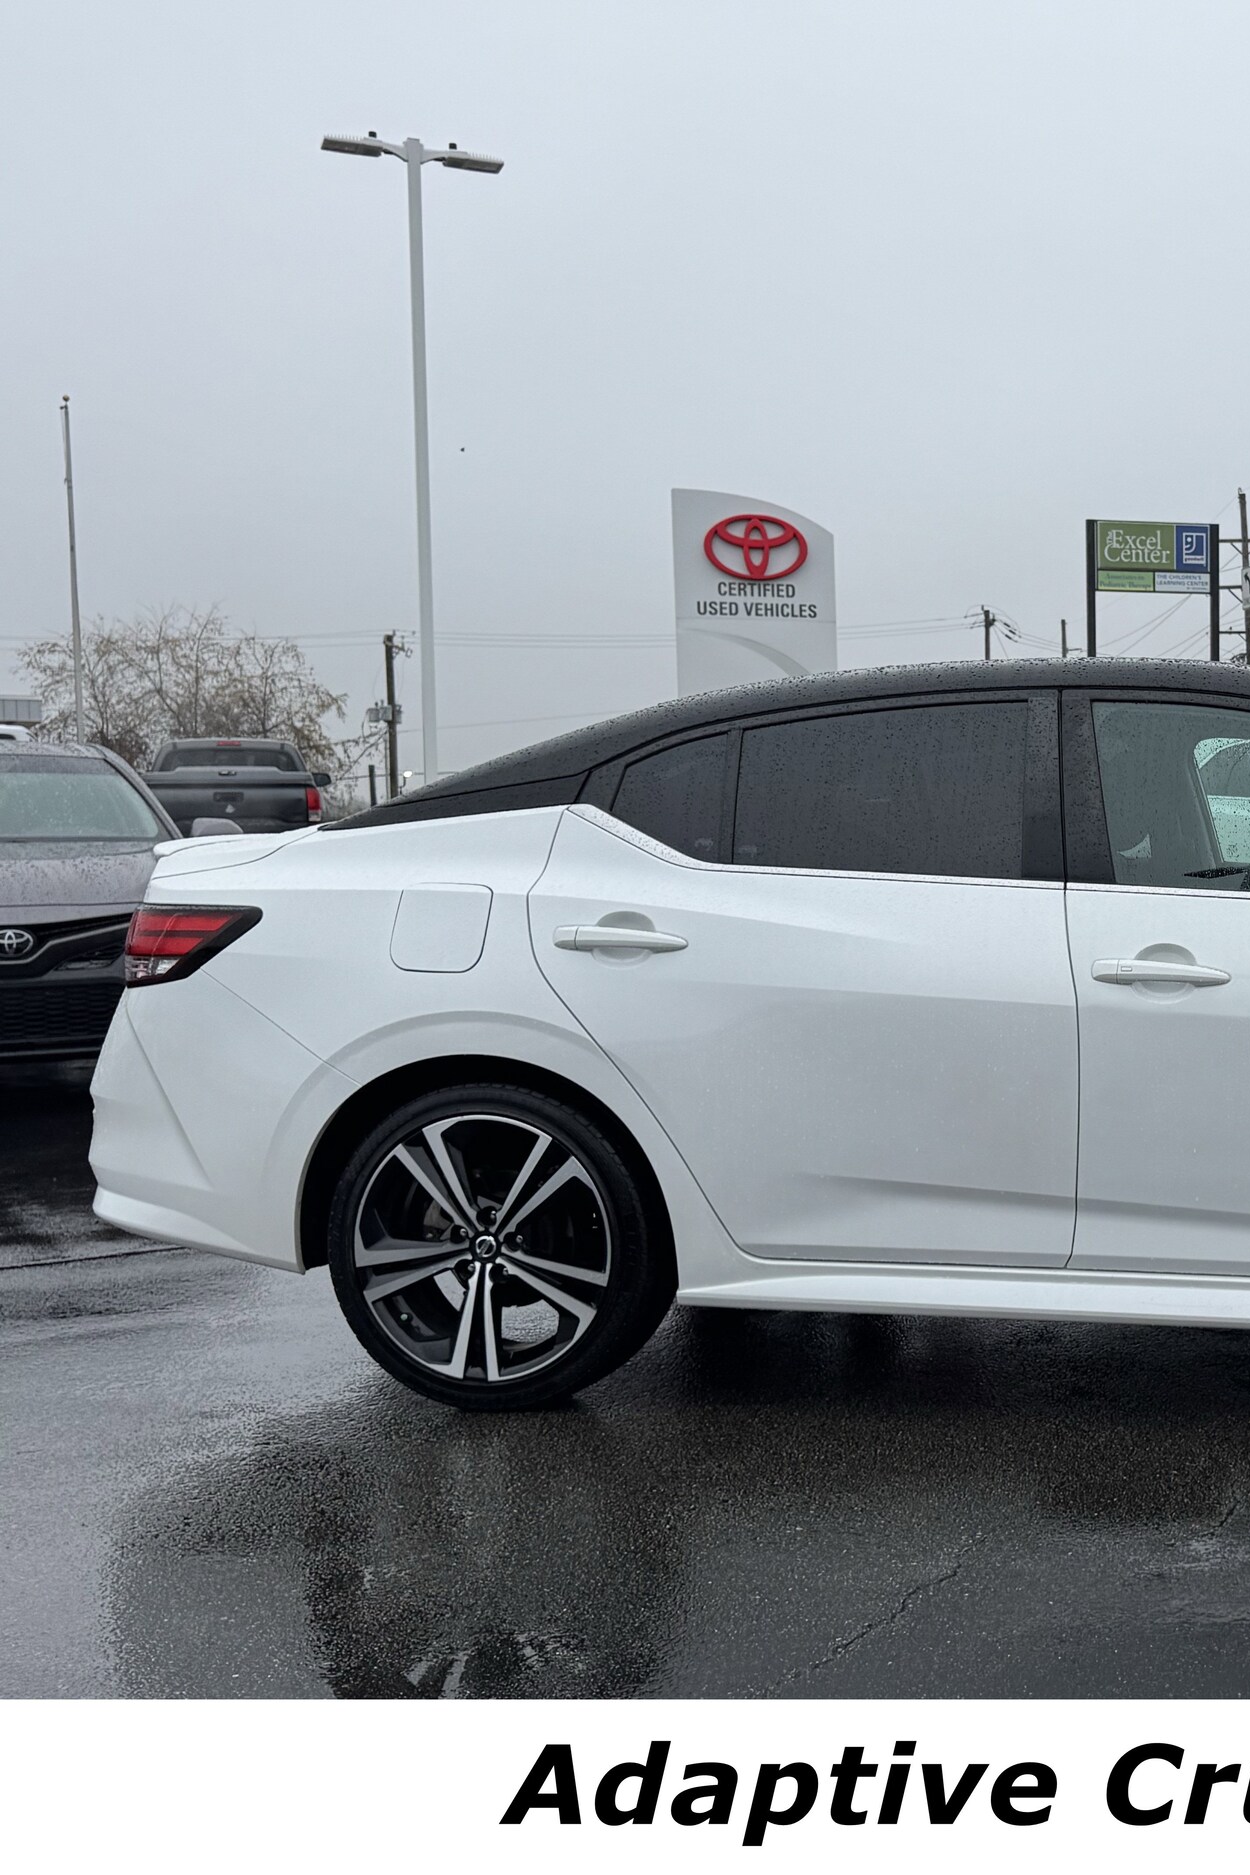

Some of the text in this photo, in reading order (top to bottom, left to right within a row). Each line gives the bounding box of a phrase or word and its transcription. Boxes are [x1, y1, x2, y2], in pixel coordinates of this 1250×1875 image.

[1111, 529, 1162, 550] Excel
[1104, 543, 1170, 564] Center
[717, 581, 796, 598] CERTIFIED
[697, 601, 817, 618] USED VEHICLES
